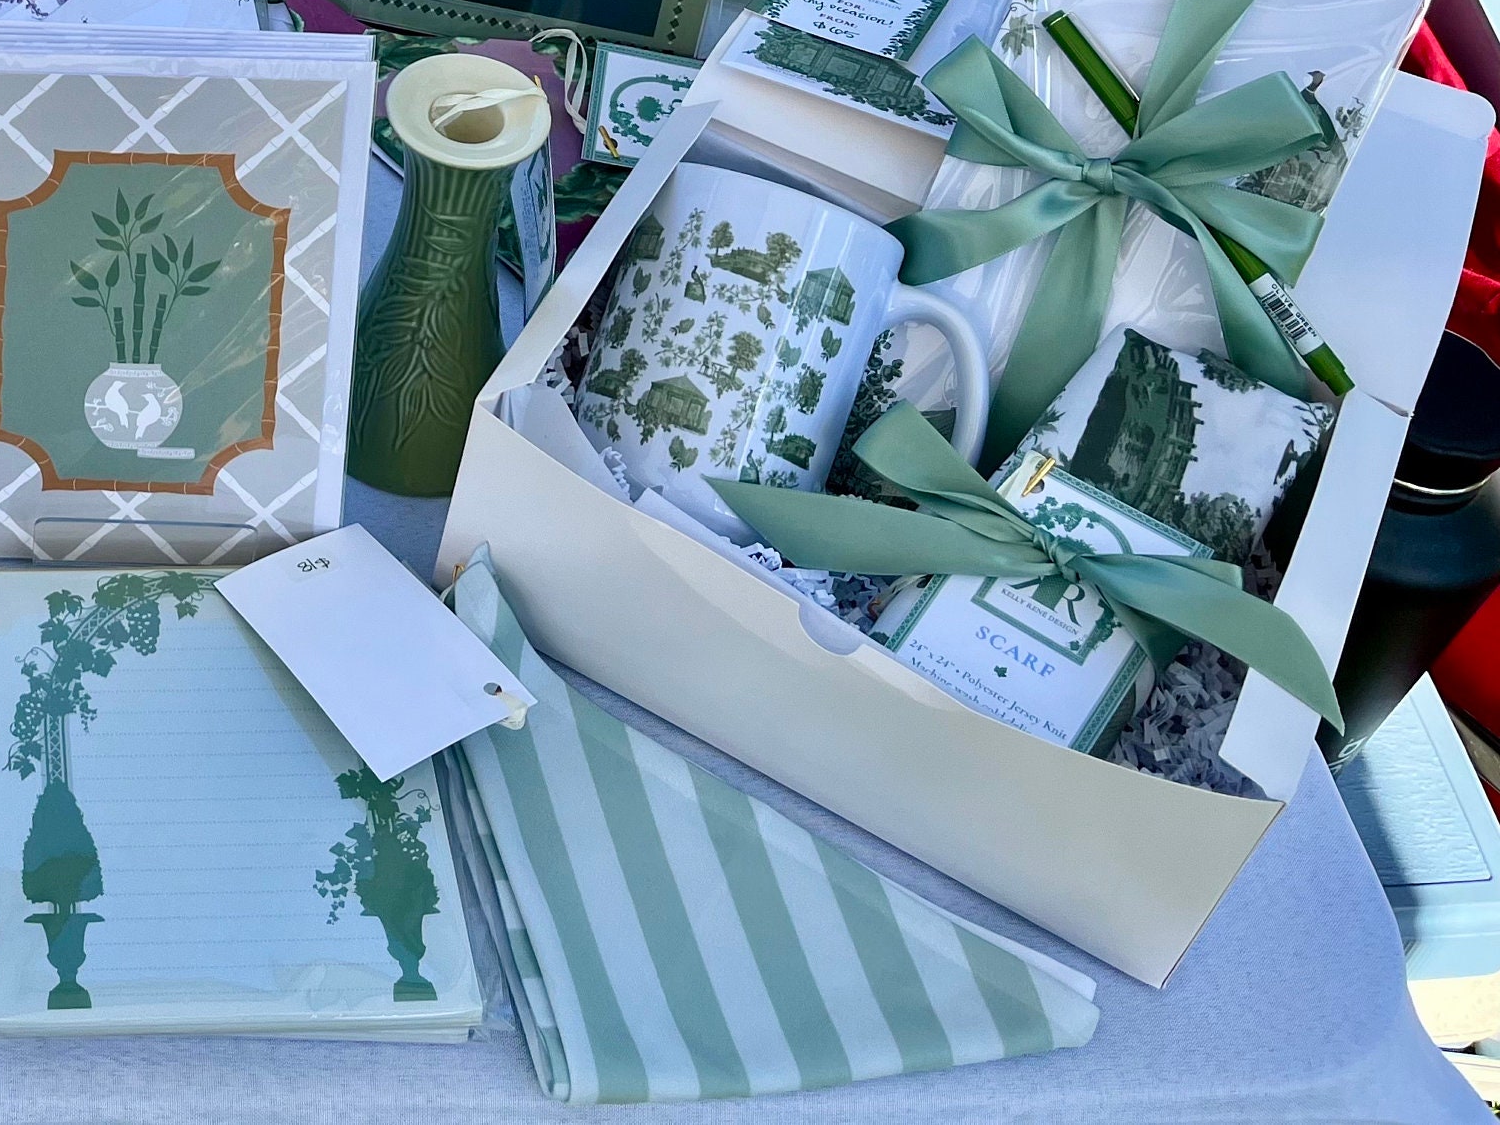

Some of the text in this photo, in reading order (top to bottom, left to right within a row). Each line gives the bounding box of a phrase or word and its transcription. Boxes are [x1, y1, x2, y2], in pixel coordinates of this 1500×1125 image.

[1271, 283, 1294, 308] OLIVE
[1296, 312, 1317, 337] GREEN
[1001, 588, 1026, 605] KELLY
[1048, 615, 1078, 635] DESIGN
[975, 625, 1056, 677] SCARF
[962, 671, 1009, 704] Polyester
[1008, 701, 1041, 724] Jersey
[1043, 720, 1068, 740] Knit
